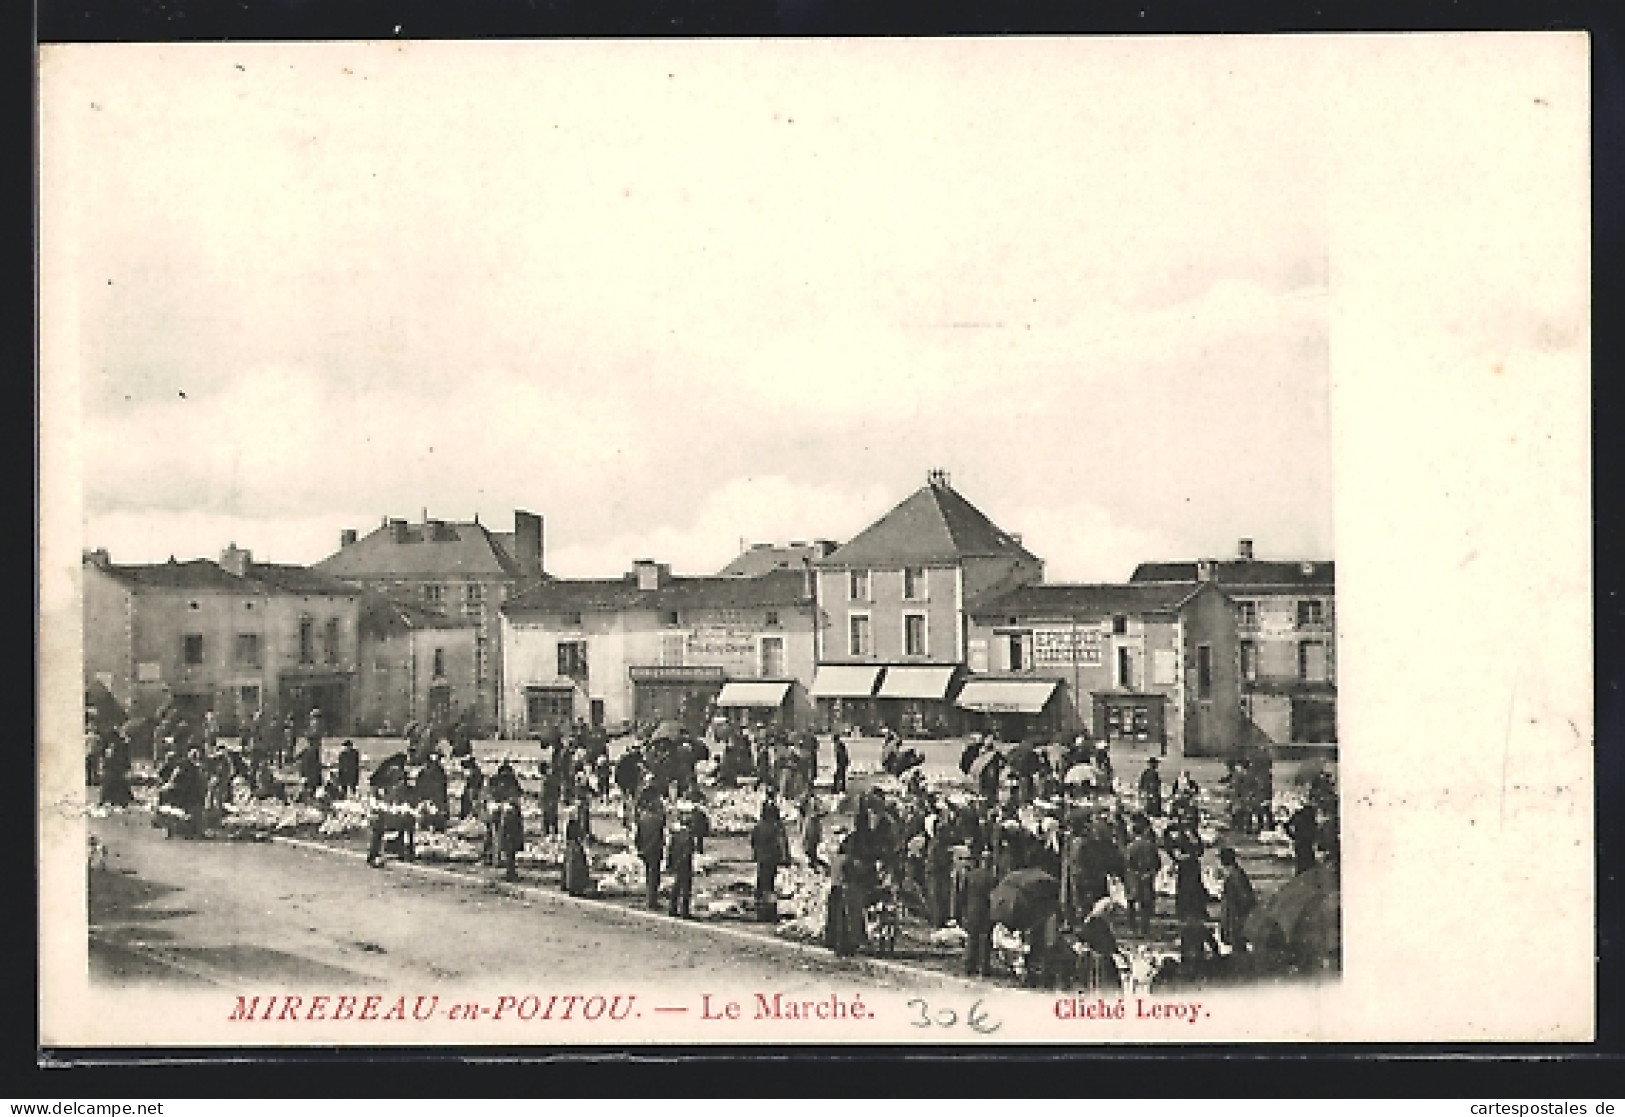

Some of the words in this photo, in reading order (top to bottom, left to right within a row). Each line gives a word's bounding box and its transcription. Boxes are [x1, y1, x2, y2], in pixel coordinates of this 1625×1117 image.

[228, 995, 642, 1021] MIREBEAU-en-POITOU.
[702, 994, 741, 1020] Le
[755, 993, 876, 1020] Marché.
[1054, 998, 1124, 1020] Cliché
[1137, 999, 1211, 1025] Leroy.
